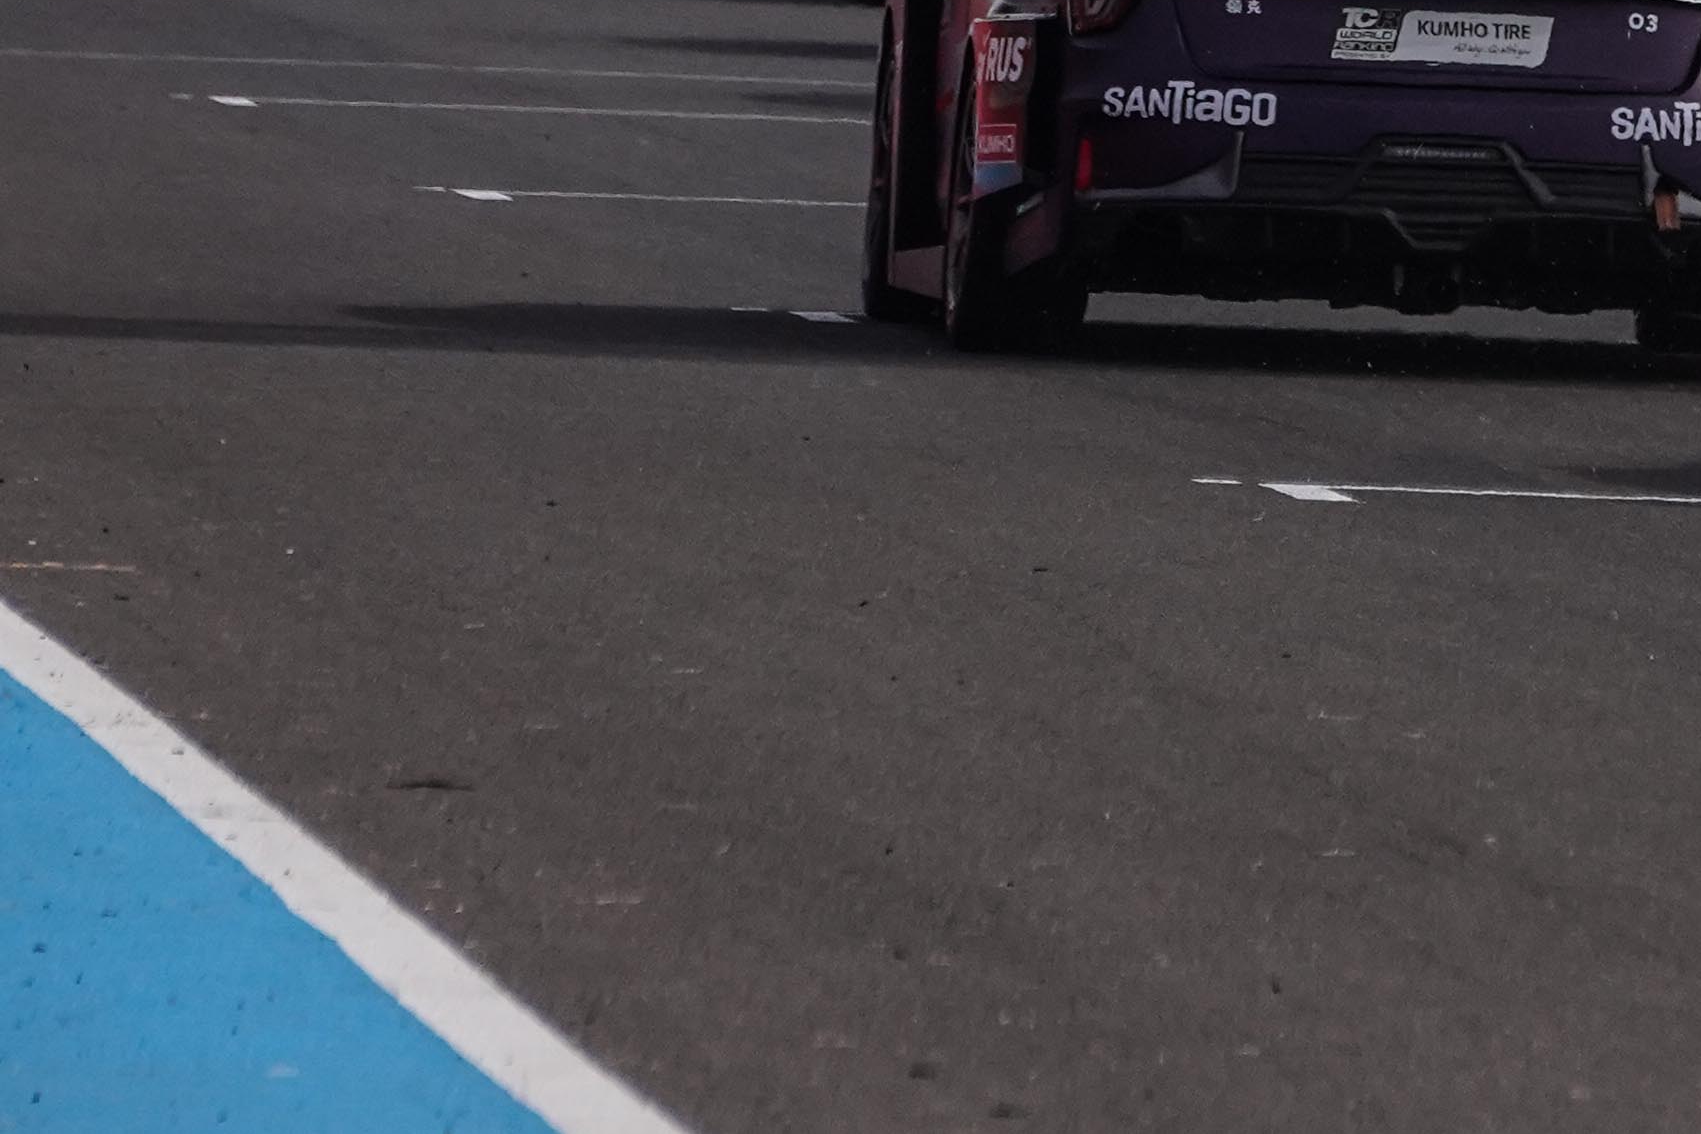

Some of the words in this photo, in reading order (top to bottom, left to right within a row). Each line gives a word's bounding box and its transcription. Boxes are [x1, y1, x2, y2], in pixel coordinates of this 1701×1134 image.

[1417, 19, 1488, 39] KUMHO
[1494, 22, 1531, 41] TIRE
[1628, 12, 1660, 34] 03
